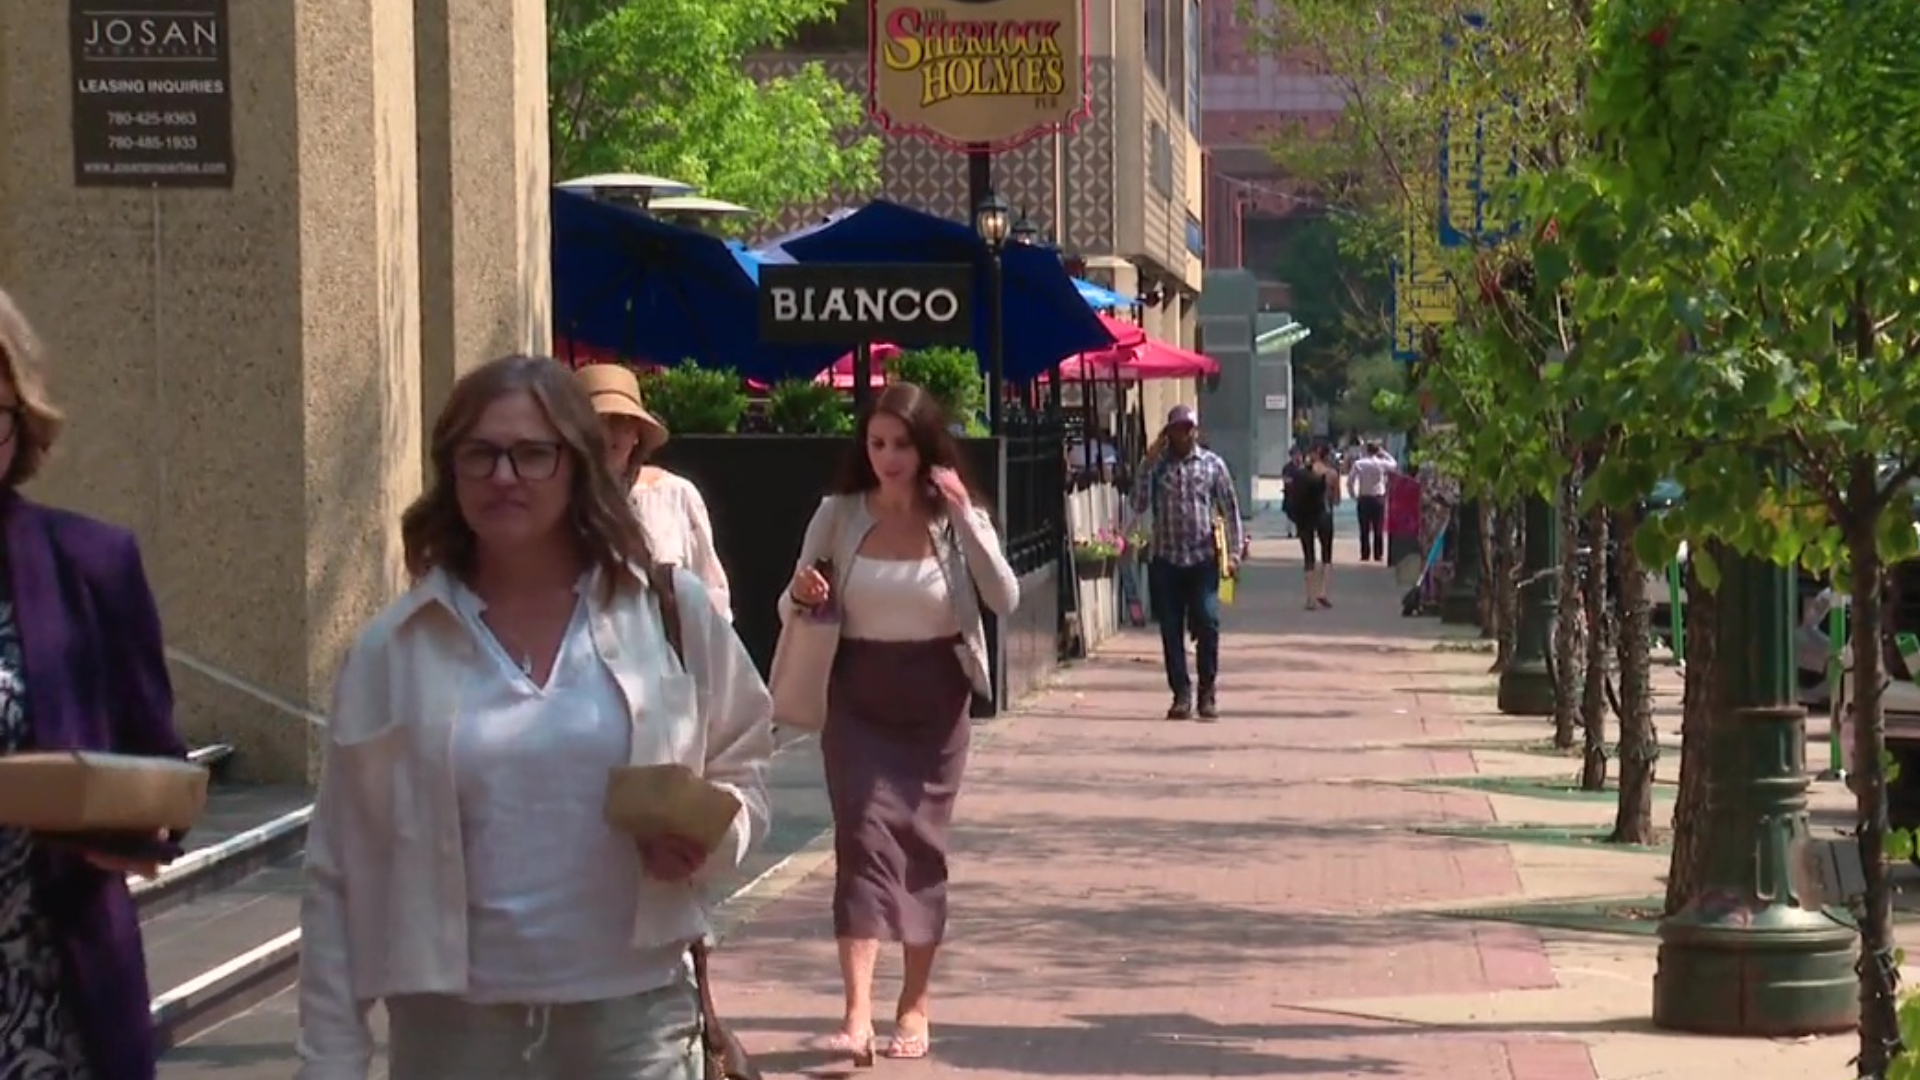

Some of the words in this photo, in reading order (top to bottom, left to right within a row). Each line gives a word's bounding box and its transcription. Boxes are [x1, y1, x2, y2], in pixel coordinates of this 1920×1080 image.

[84, 18, 216, 45] JOSAN
[882, 6, 1062, 71] SHERLOCK
[78, 79, 145, 93] LEASING
[148, 79, 224, 93] INQUIRIES
[920, 56, 1065, 108] HOLMES
[770, 286, 958, 322] BIANCO
